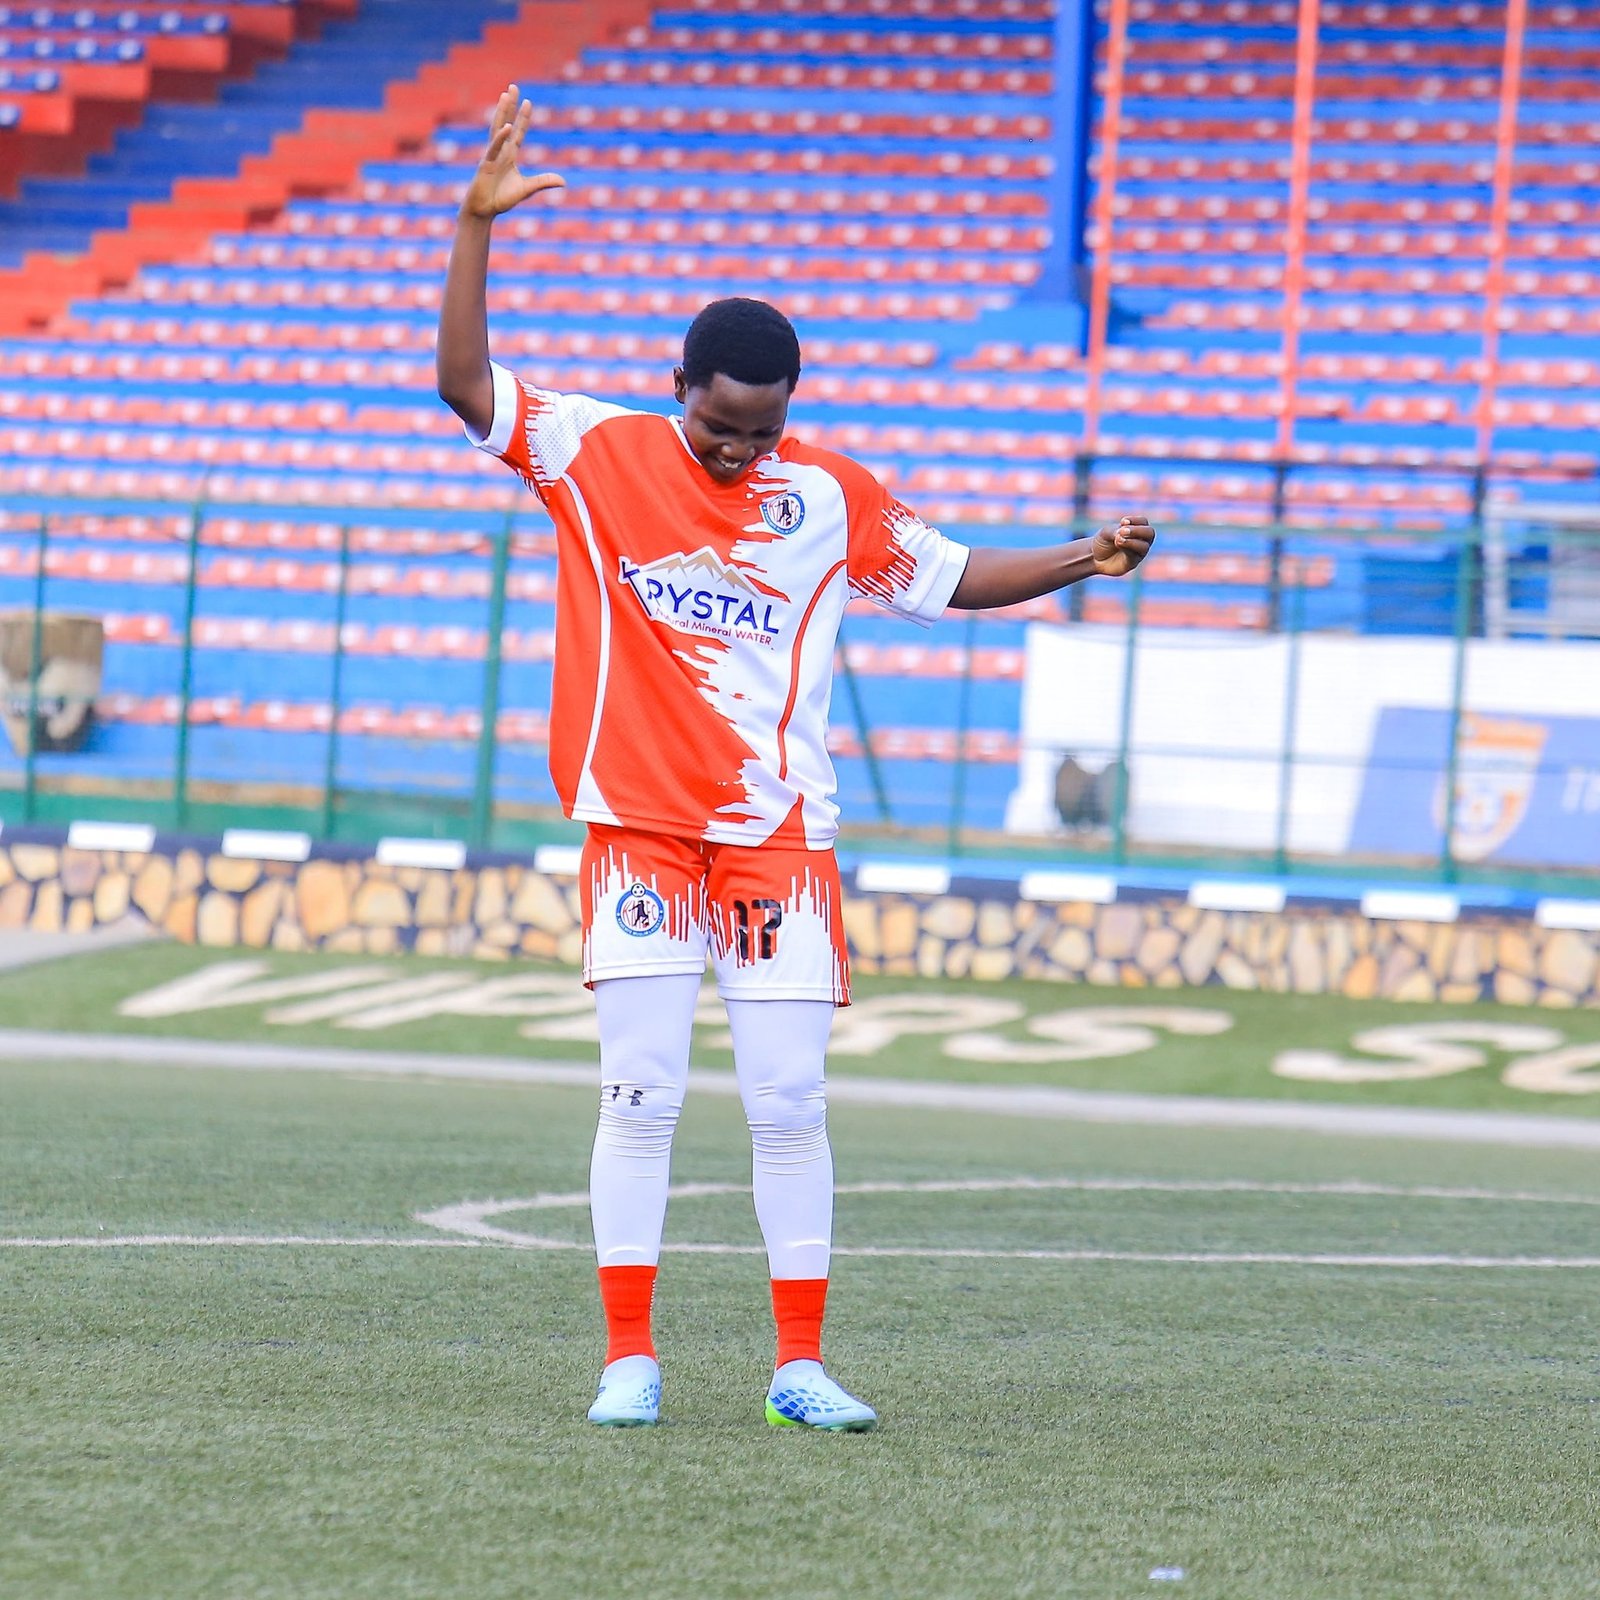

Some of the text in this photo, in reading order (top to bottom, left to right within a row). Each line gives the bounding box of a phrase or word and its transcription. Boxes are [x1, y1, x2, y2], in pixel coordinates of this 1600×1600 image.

[691, 621, 732, 637] Mineral
[735, 629, 772, 645] WATER
[733, 899, 782, 960] 17
